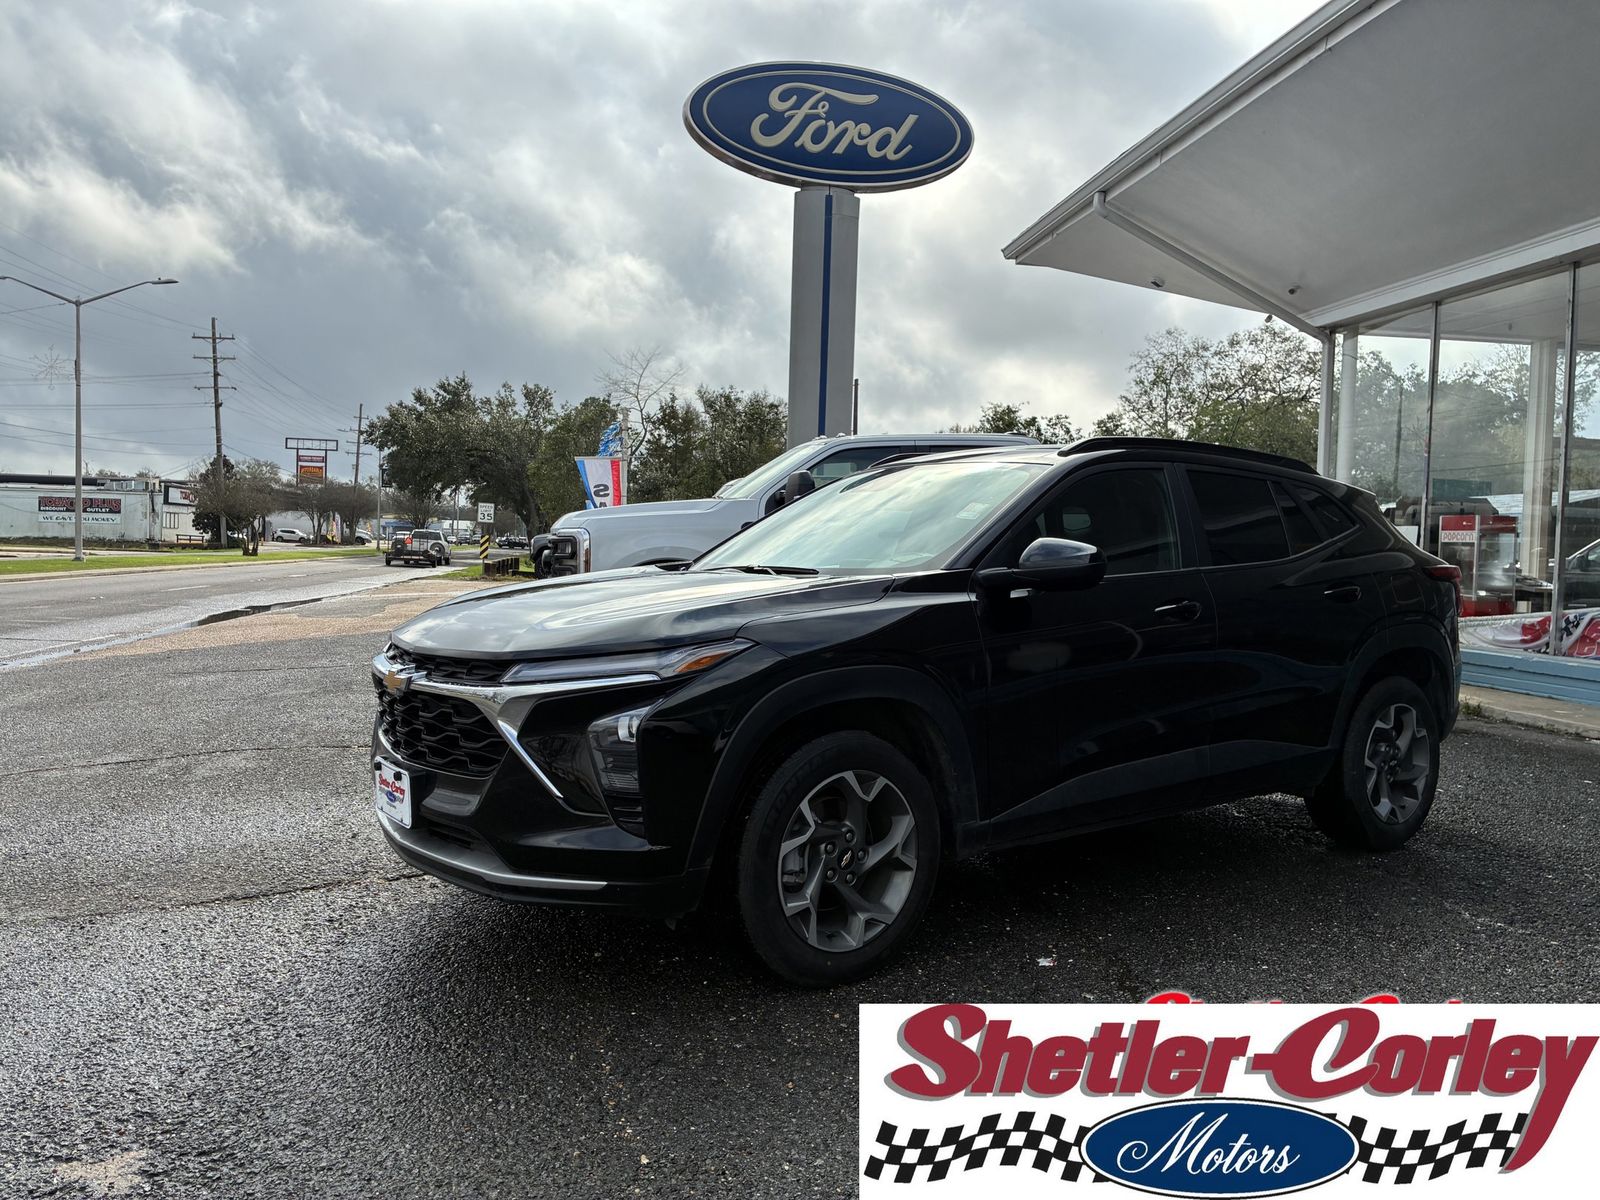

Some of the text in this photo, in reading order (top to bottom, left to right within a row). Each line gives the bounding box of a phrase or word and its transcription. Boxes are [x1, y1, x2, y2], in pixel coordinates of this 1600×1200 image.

[750, 82, 919, 161] Ford
[41, 497, 121, 512] TOBACO PLUS
[479, 512, 493, 521] 35
